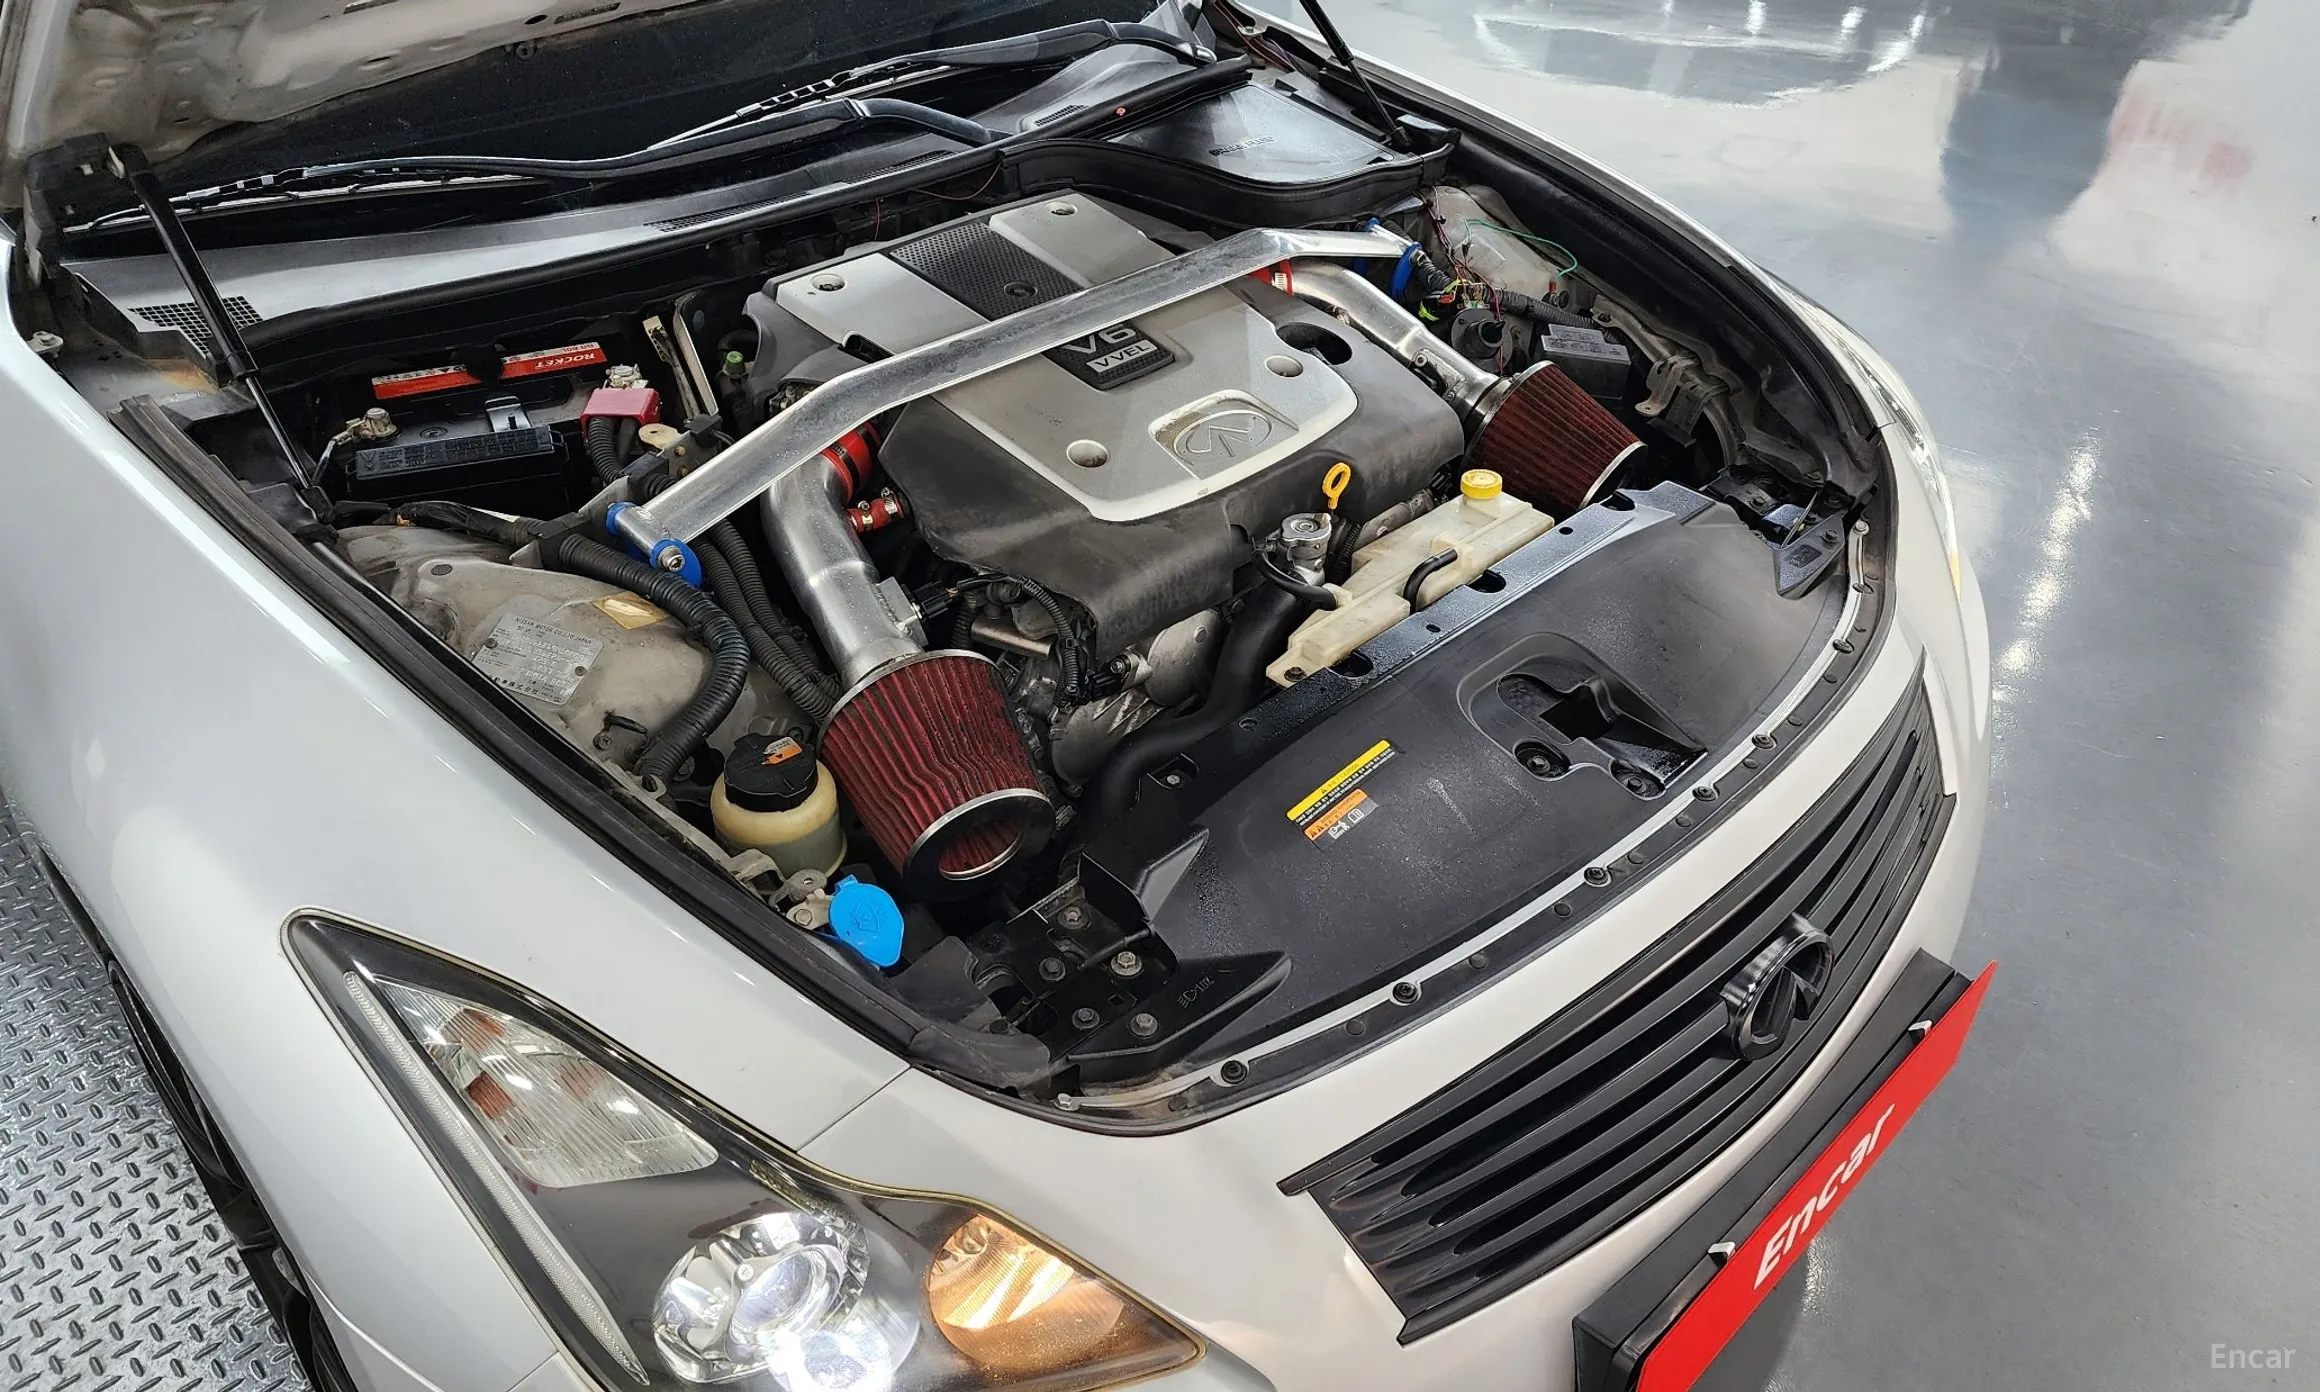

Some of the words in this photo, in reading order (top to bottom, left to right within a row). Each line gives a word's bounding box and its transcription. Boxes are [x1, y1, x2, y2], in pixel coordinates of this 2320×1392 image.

[1061, 323, 1137, 354] V6
[535, 352, 595, 369] ROCKET
[1092, 345, 1151, 367] VVEL
[1754, 1103, 1895, 1290] Encar
